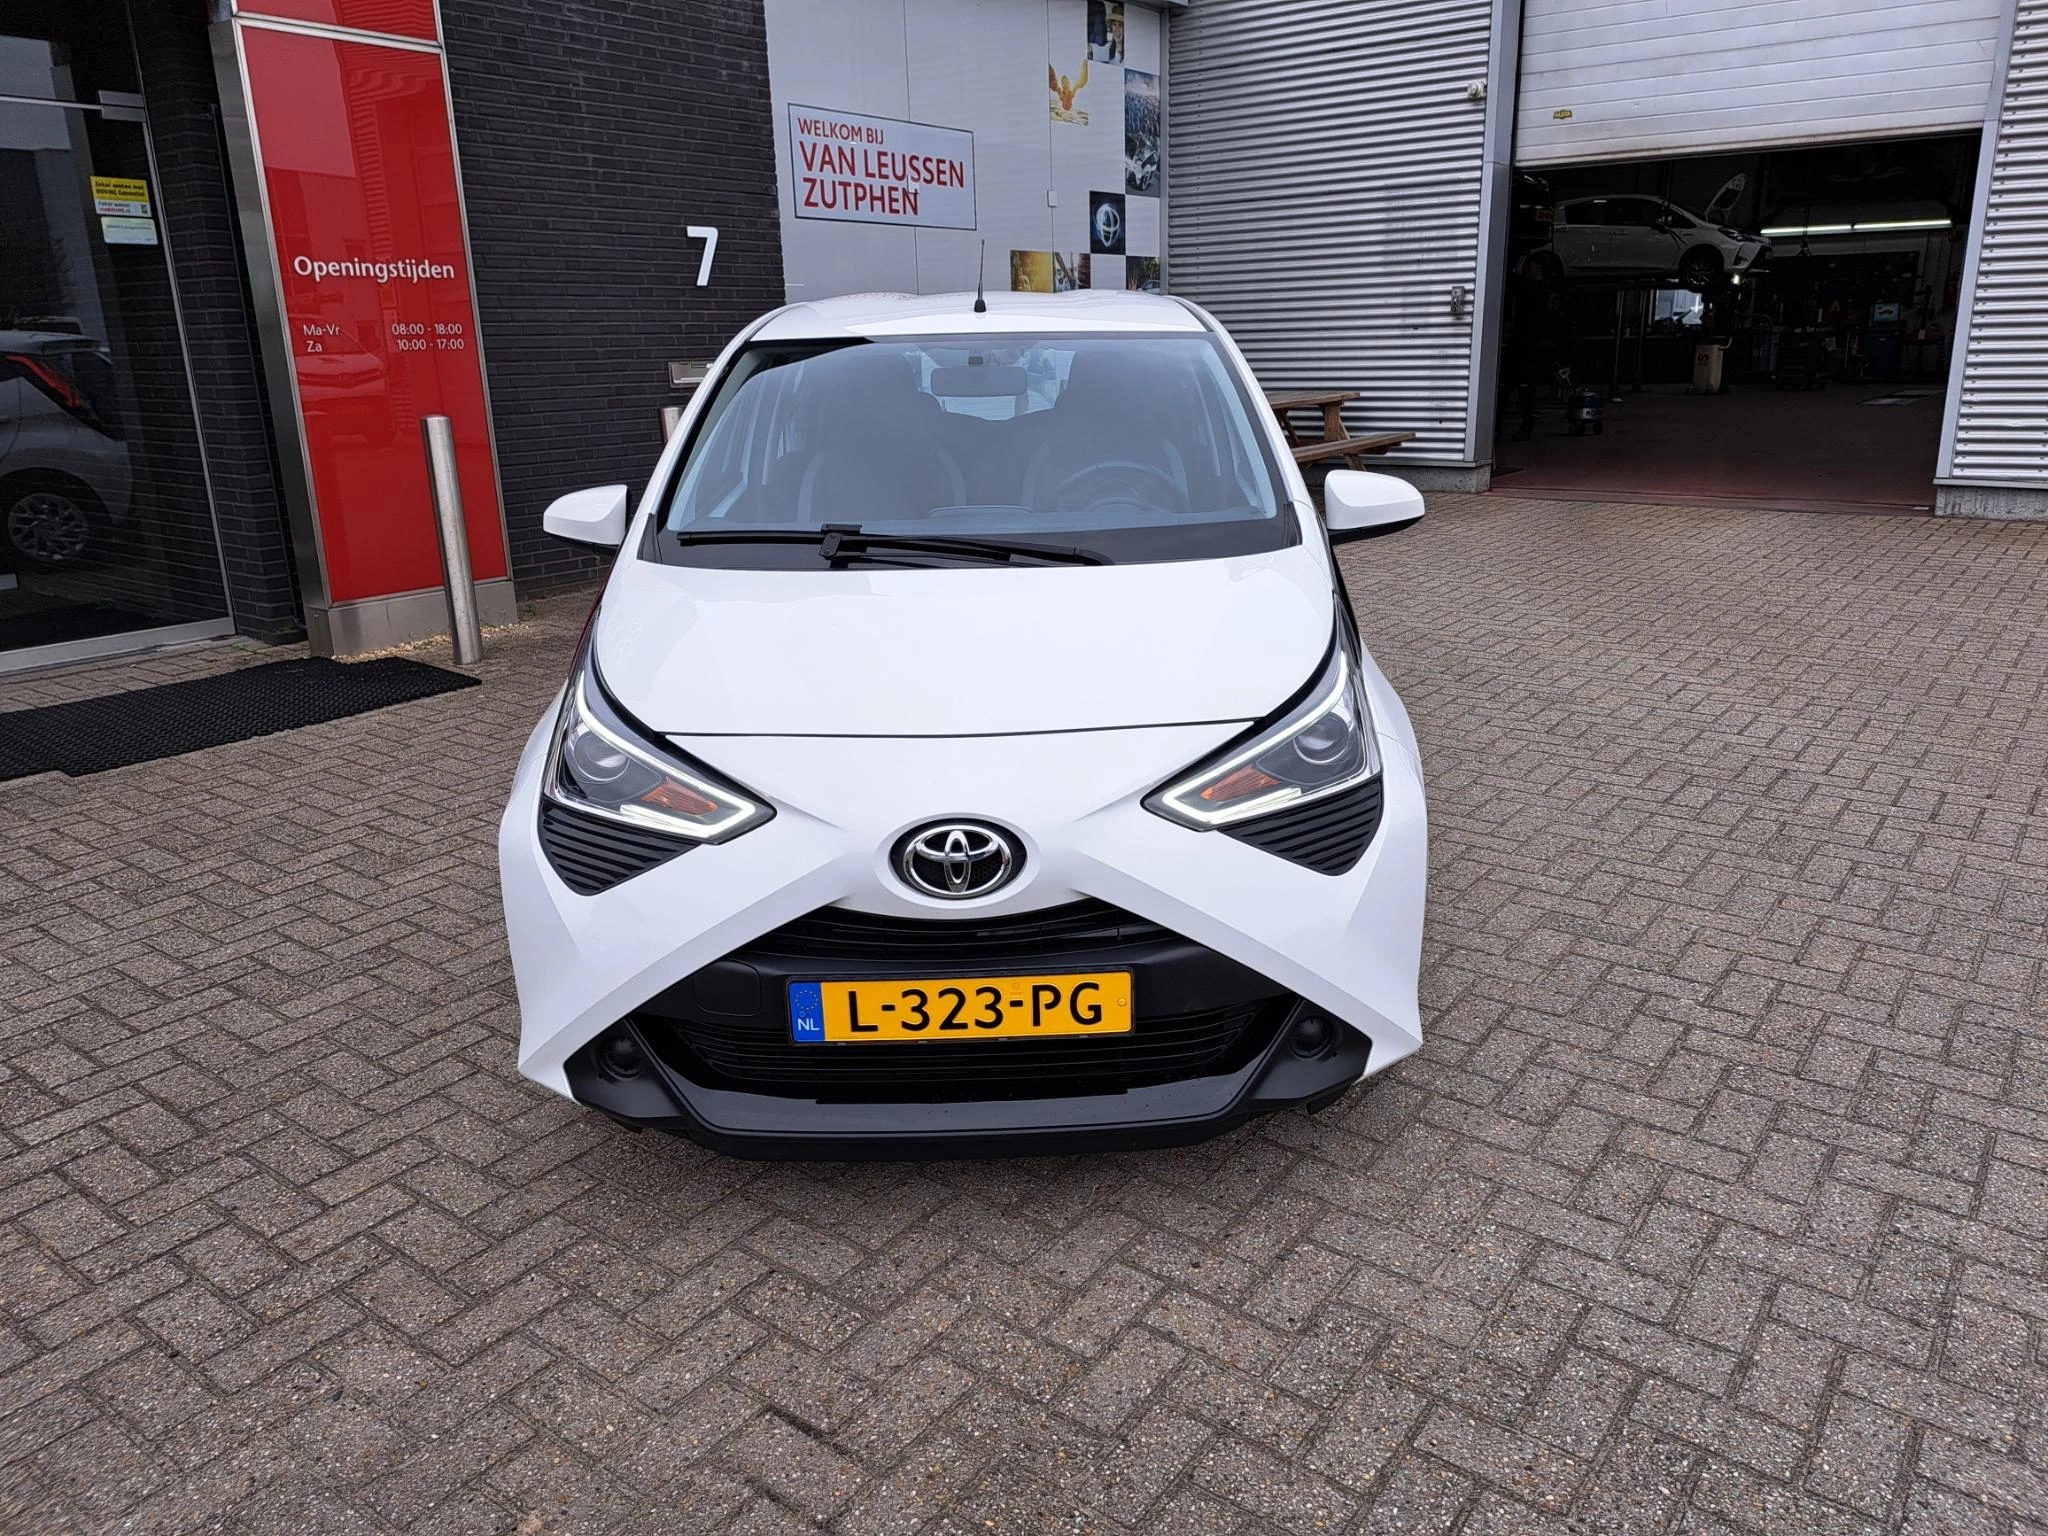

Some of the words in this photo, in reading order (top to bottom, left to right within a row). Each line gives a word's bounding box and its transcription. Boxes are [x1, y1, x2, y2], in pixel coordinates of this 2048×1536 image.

[797, 117, 863, 143] WELKOM
[866, 127, 884, 145] BIJ
[799, 140, 856, 176] VAN
[863, 148, 964, 188] LEUSSEN
[802, 177, 918, 216] ZUTPHEN
[294, 255, 455, 283] Openingstijden
[686, 226, 718, 286] 7
[303, 323, 340, 336] Ma-Vr
[391, 323, 424, 335] 08:00
[434, 323, 462, 335] 18:00
[306, 340, 323, 352] Za
[396, 339, 427, 351] 10:00
[435, 338, 464, 350] 17:00
[797, 1017, 819, 1031] NL
[848, 981, 1103, 1033] L-323-PG
